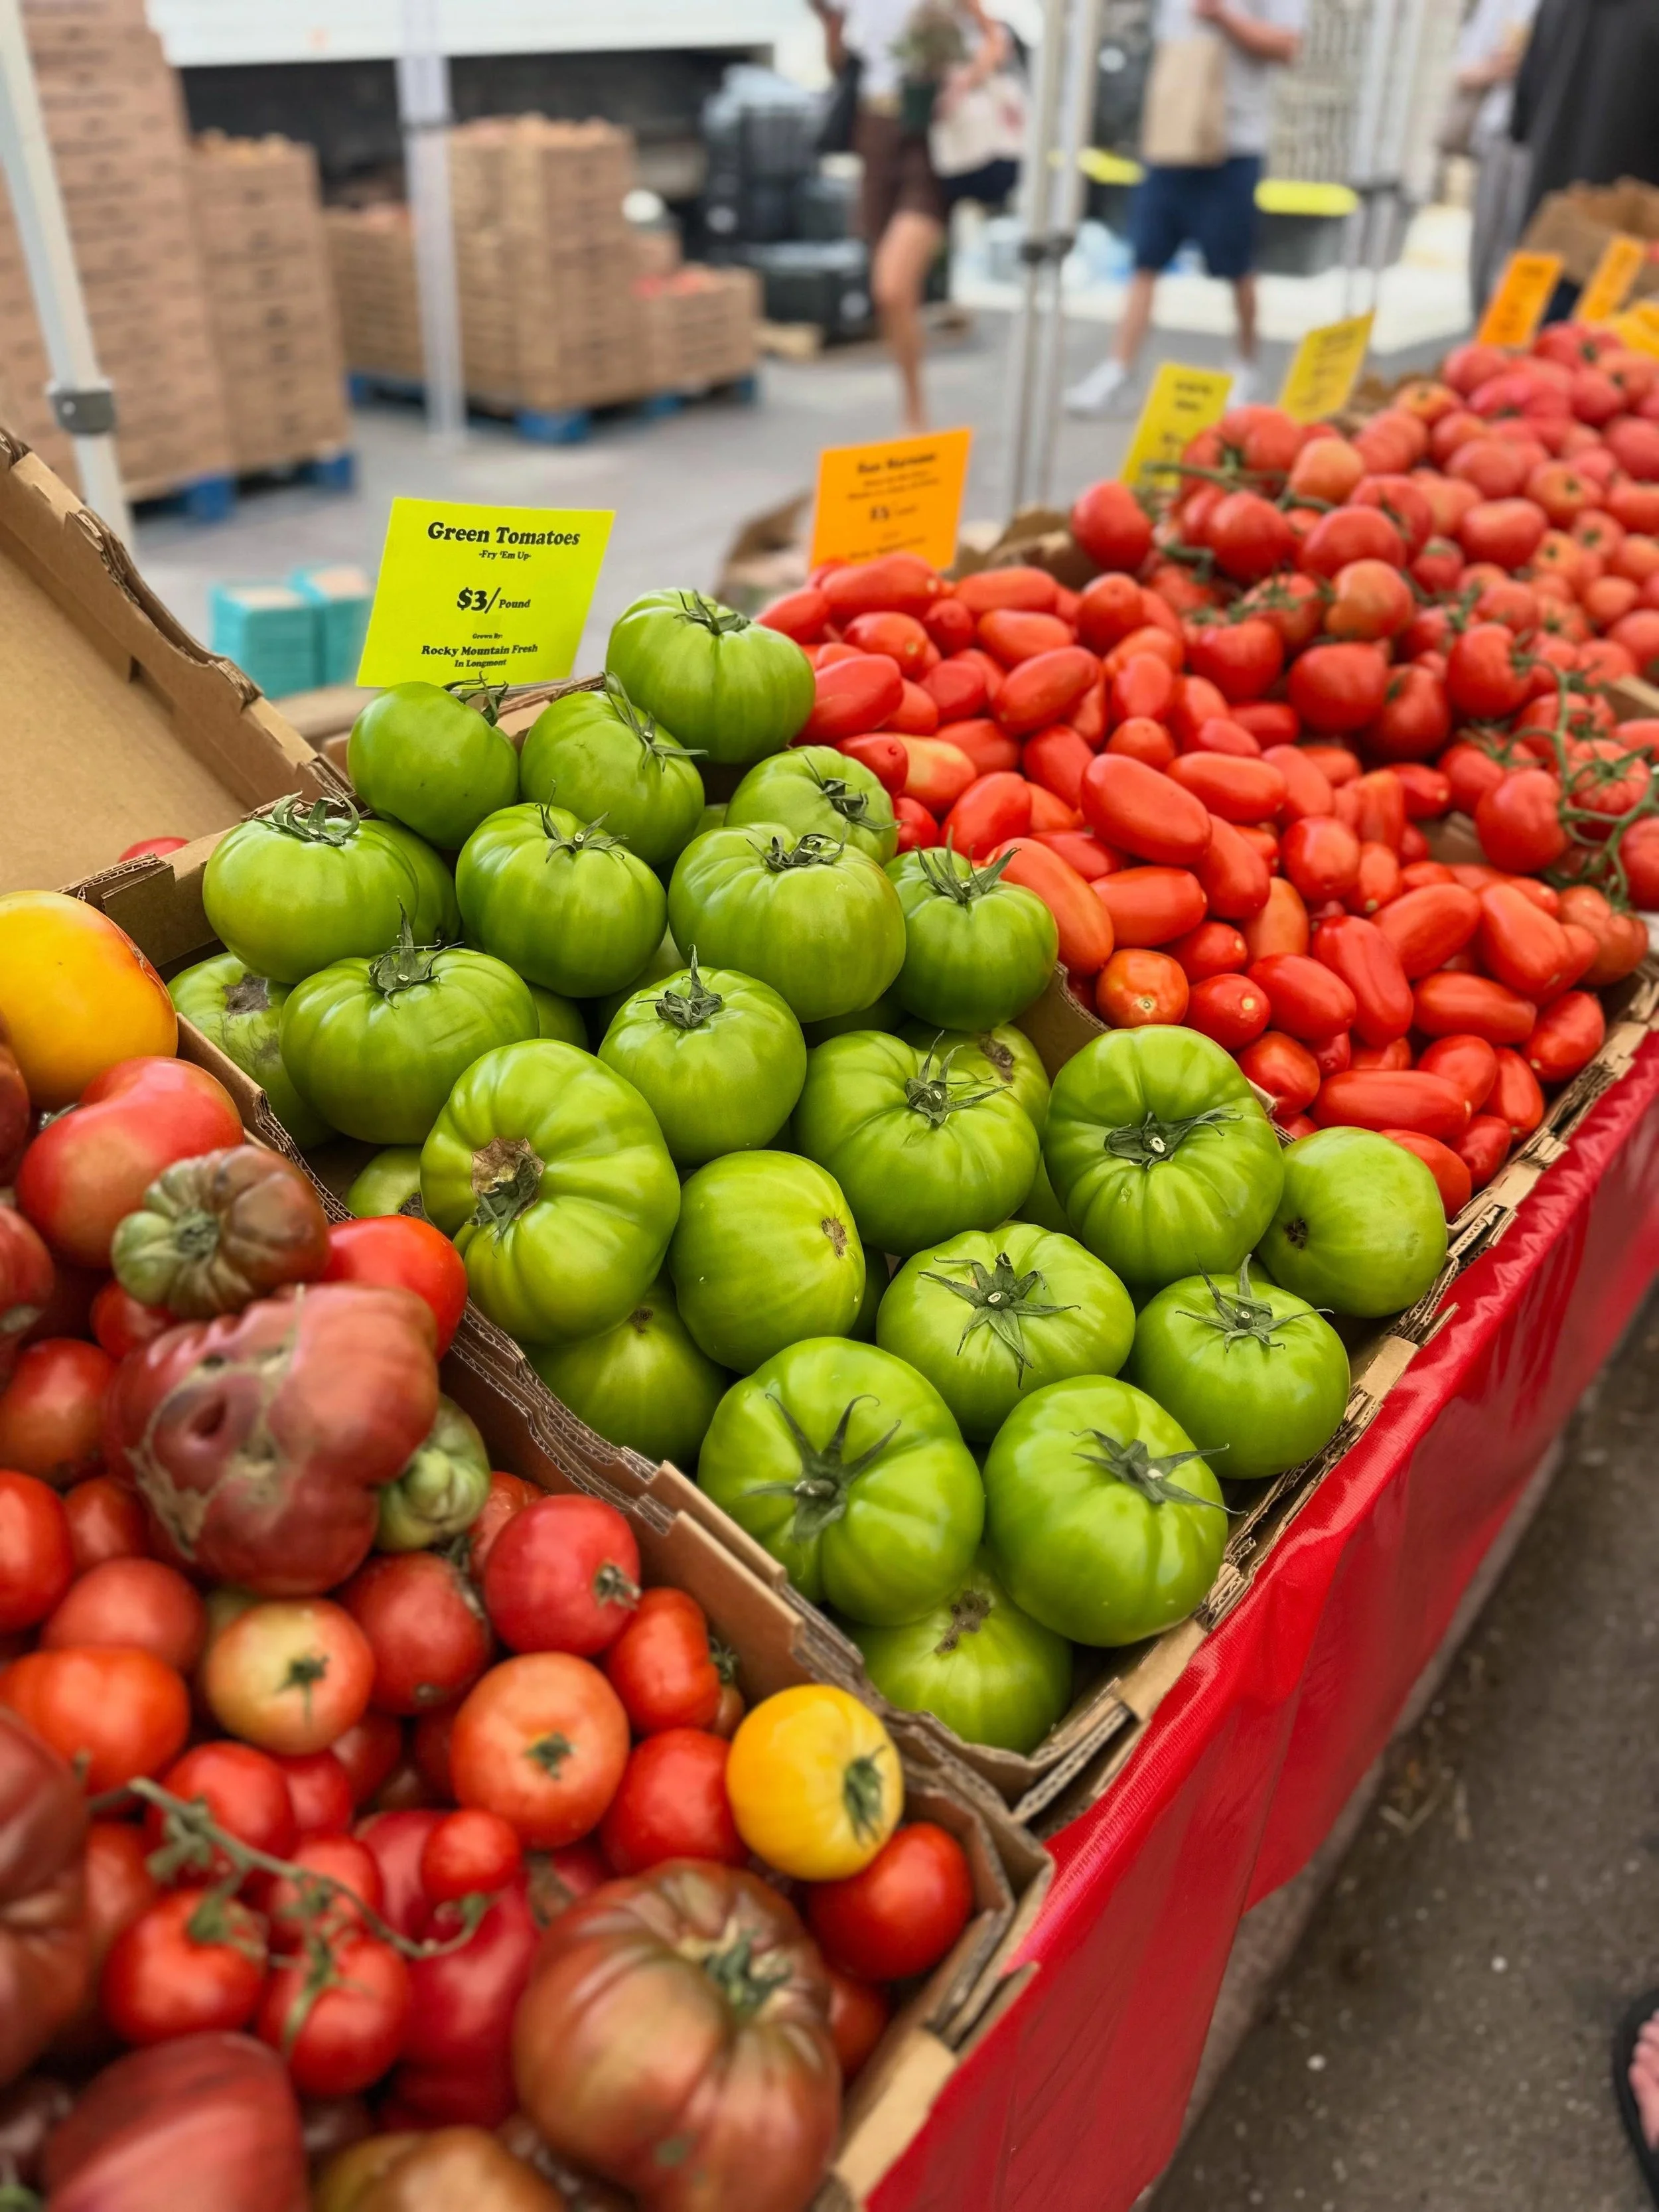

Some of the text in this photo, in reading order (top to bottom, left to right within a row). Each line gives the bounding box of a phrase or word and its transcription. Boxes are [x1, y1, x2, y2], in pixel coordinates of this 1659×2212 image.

[427, 521, 581, 546] Green Tomatoes
[421, 644, 538, 658] Rocky Mountain Fresh
[454, 658, 508, 669] In Longmont
